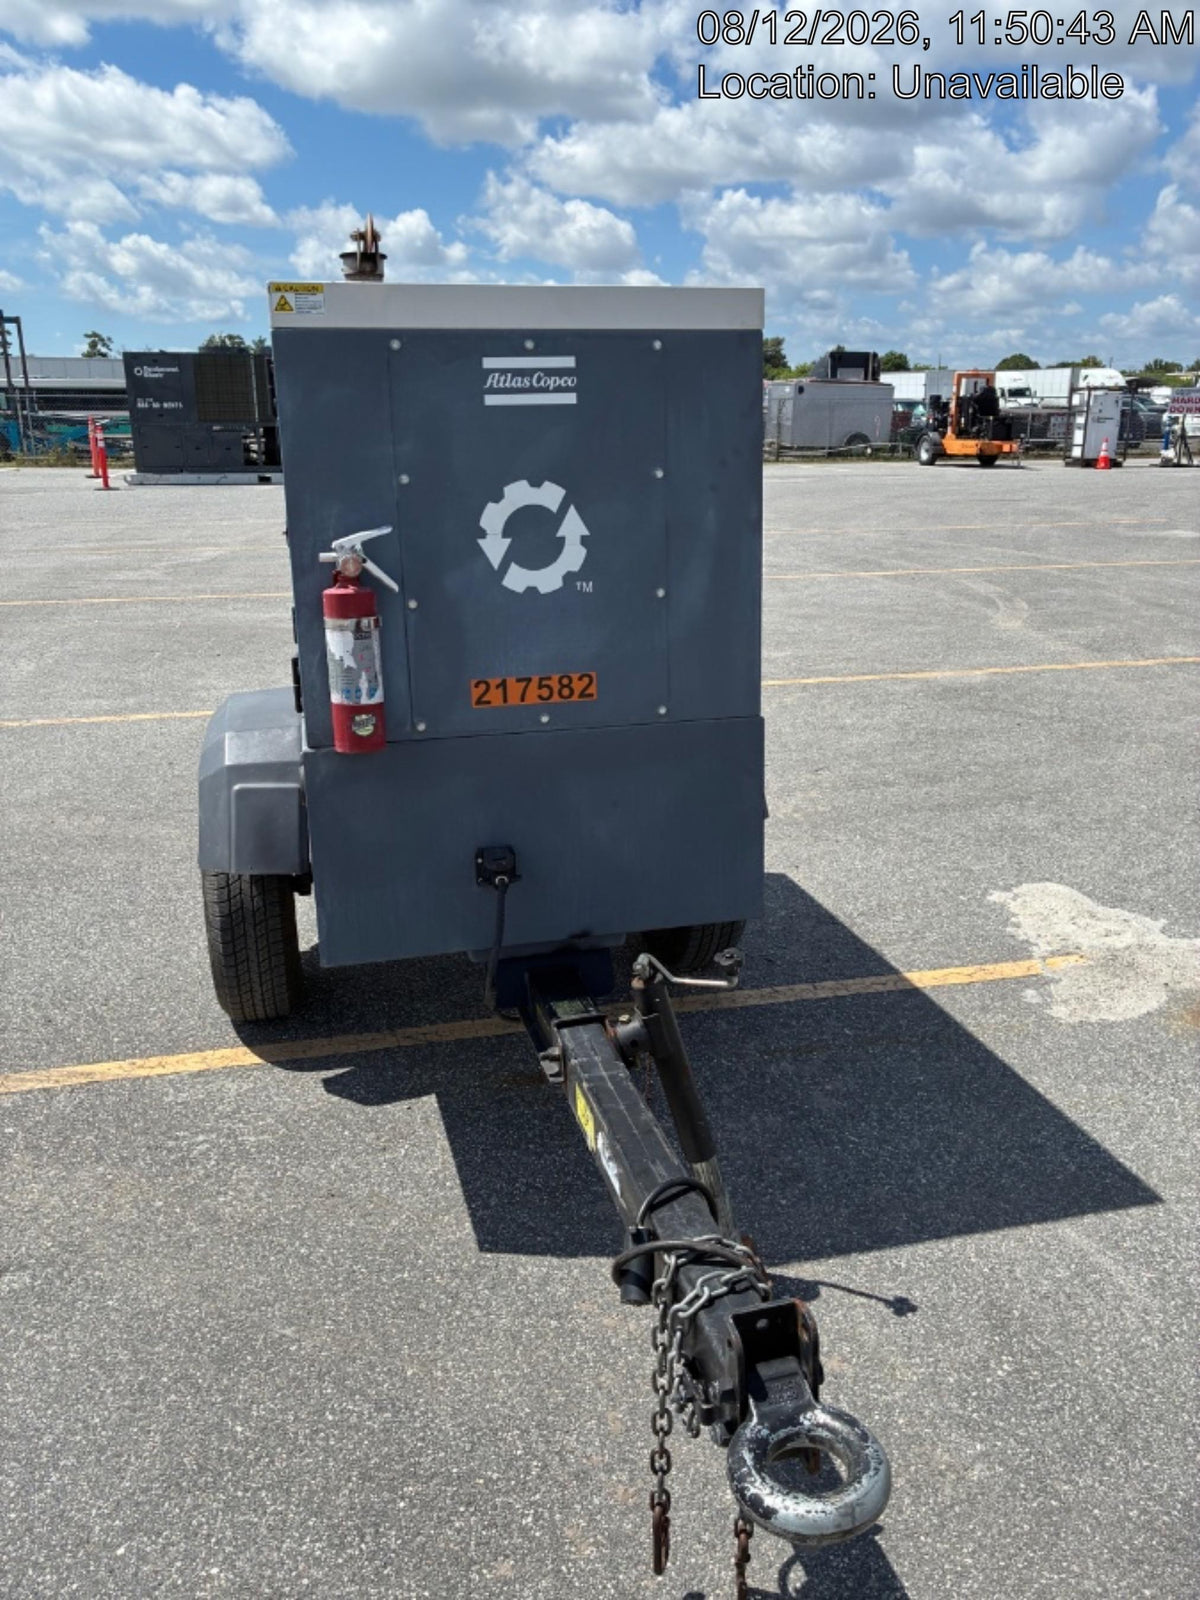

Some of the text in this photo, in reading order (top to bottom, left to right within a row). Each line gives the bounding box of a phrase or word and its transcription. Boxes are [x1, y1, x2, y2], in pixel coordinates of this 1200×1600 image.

[484, 371, 577, 391] Atlas Copco
[474, 673, 594, 706] 217582
